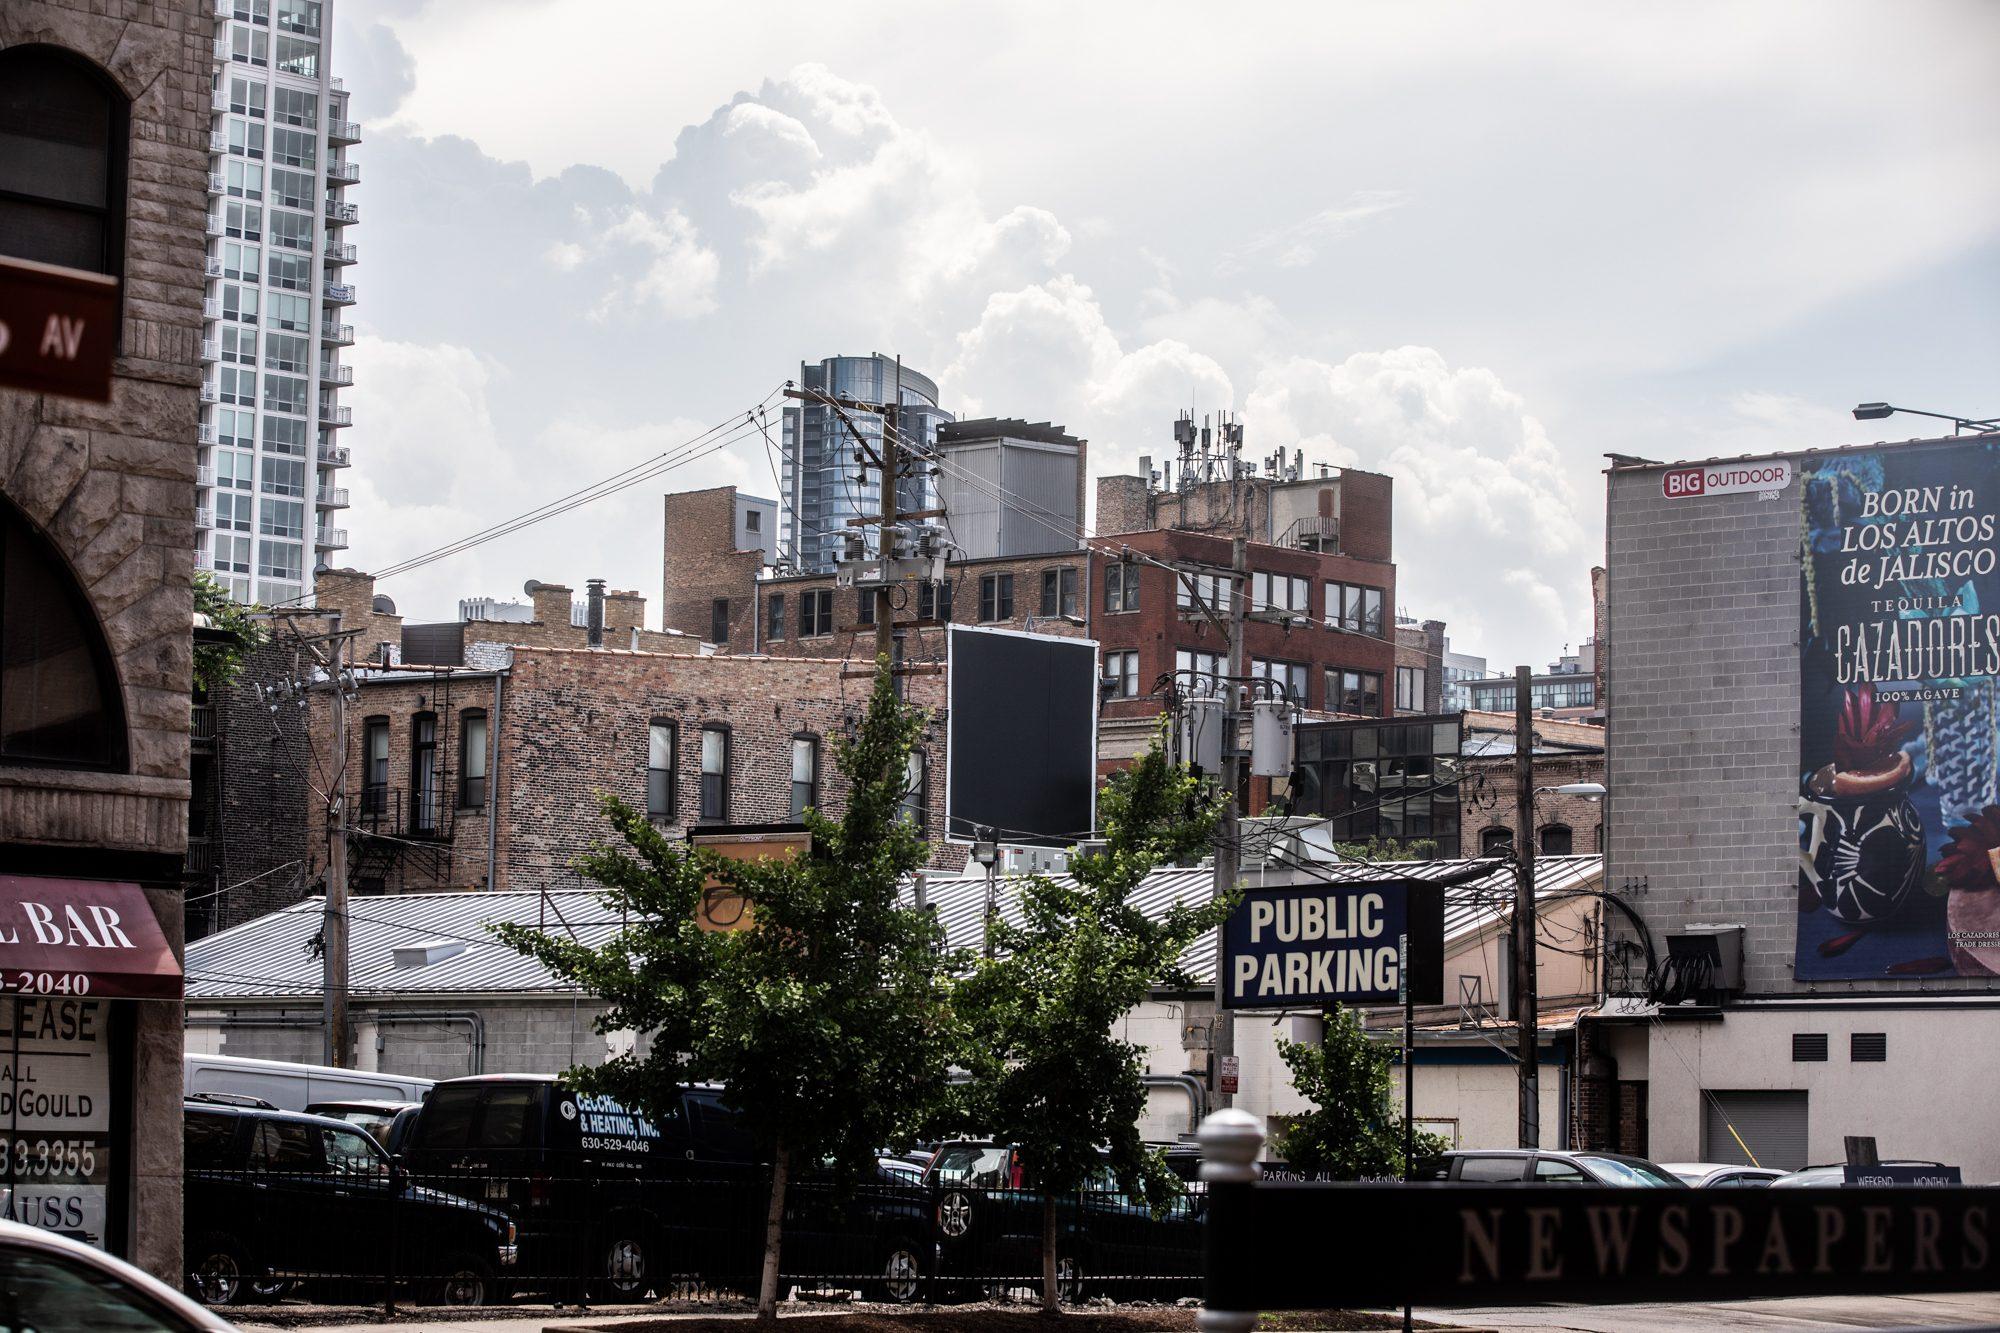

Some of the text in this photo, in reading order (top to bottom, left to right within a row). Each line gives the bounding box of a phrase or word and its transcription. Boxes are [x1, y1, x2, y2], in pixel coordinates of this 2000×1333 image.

[40, 313, 85, 361] AV
[1669, 467, 1784, 494] BIG OUTDOOR
[1860, 484, 1974, 518] BORN in
[1840, 514, 1996, 552] LOS ALTOS
[1840, 547, 1996, 590] de JALISCO
[1871, 595, 1962, 613] TEQUILA
[1834, 613, 2000, 684] CAZADORES
[1875, 688, 1960, 703] 100% AGAVE
[19, 902, 137, 949] BAR
[1250, 893, 1384, 943] PUBLIC
[1234, 946, 1398, 997] PARKING
[19, 1088, 93, 1117] GOULD
[589, 1114, 638, 1140] HEATING,
[581, 1136, 650, 1153] 630-529-4046
[1262, 1170, 1306, 1182] PARKING
[1314, 1171, 1332, 1183] ALL
[1857, 1176, 1949, 1187] WEEKEND MONTHLY
[1458, 1205, 1990, 1282] NEWSPAPERS
